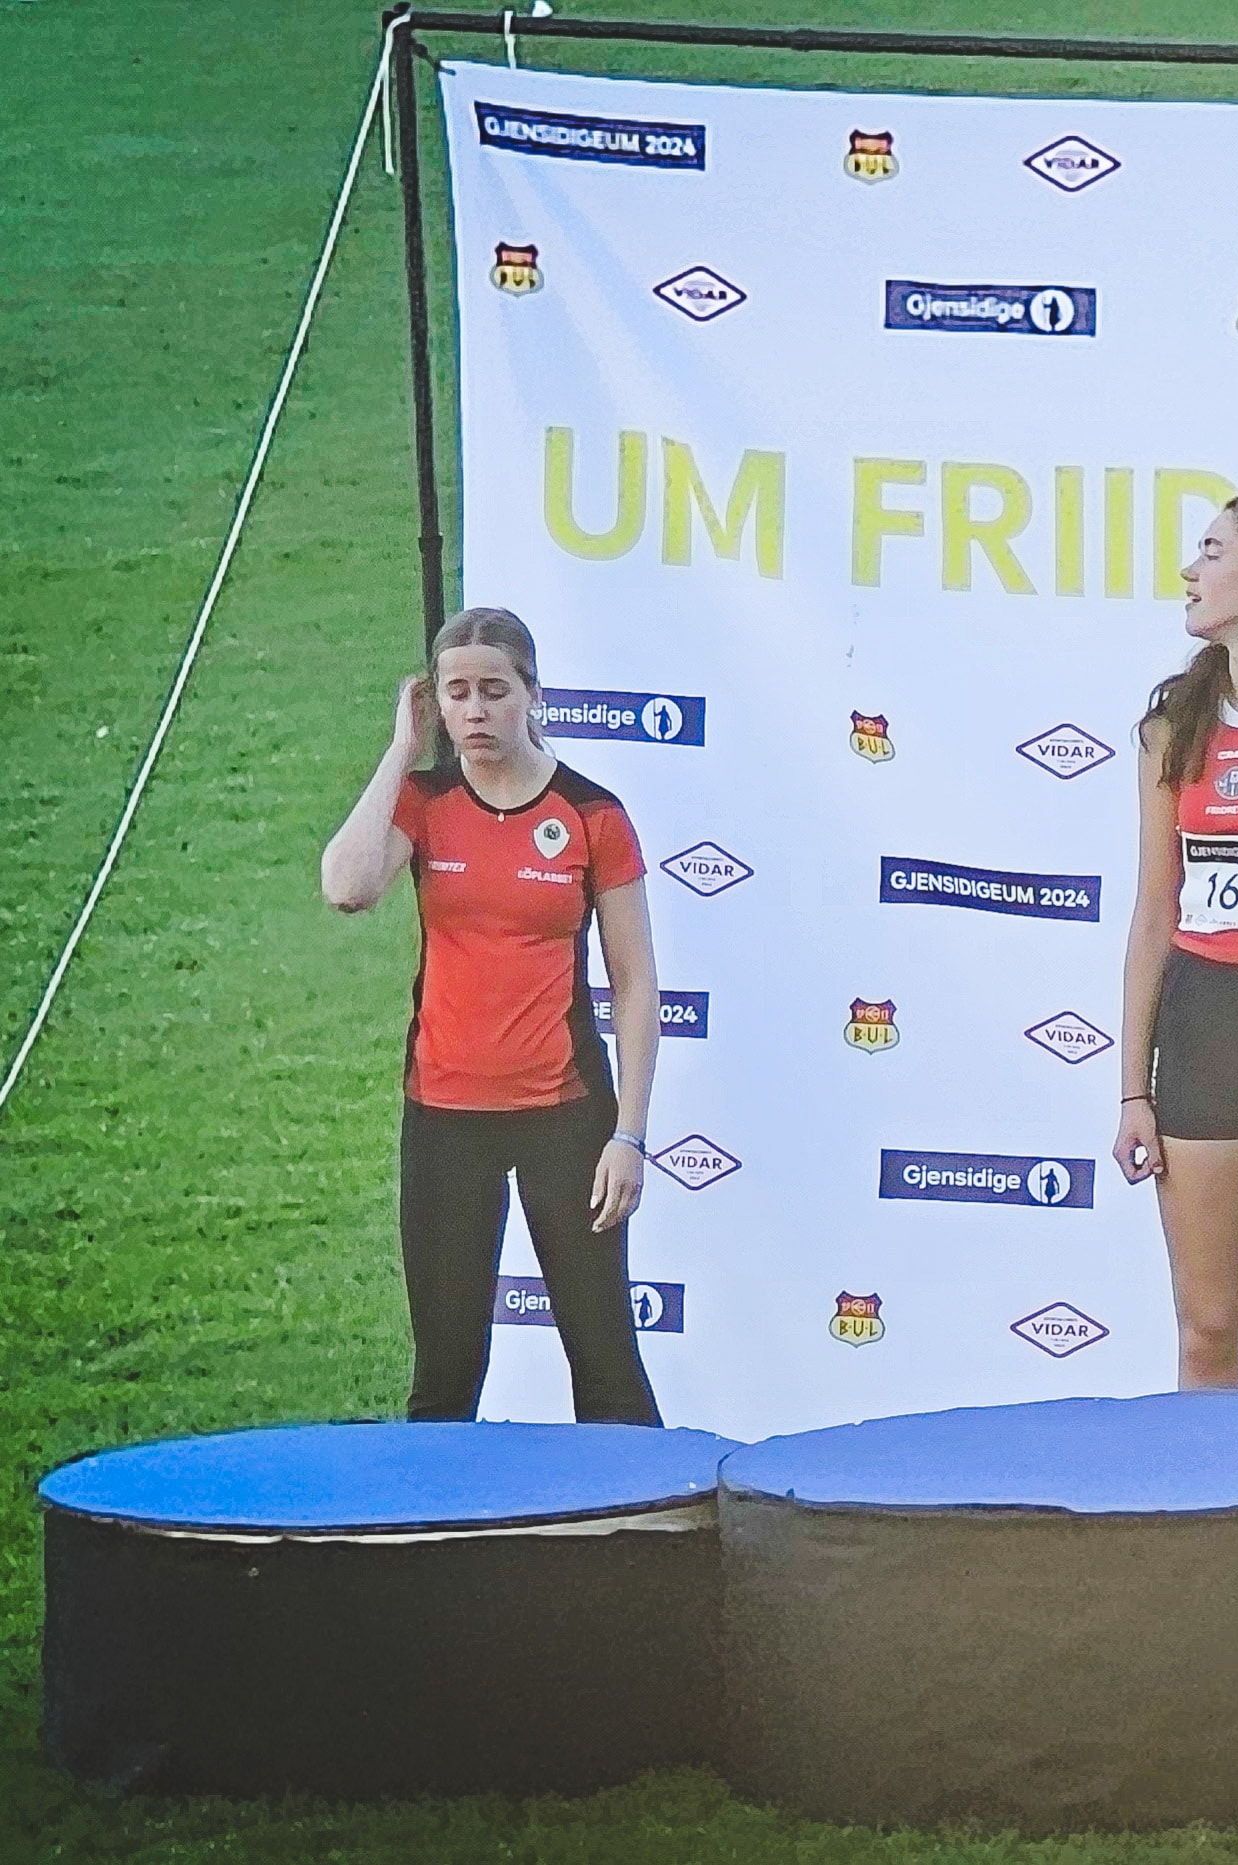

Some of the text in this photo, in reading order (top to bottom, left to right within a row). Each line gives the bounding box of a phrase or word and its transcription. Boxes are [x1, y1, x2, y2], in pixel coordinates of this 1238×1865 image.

[645, 135, 697, 157] 2024
[906, 293, 1026, 323] Gjensidige
[543, 426, 786, 580] UM
[1037, 744, 1095, 759] VIDAR
[679, 860, 735, 878] VIDAR
[890, 870, 1091, 908] GJENSIDIGEUM 2024
[660, 1004, 698, 1024] 024
[1045, 1028, 1098, 1046] VIDAR
[669, 1155, 723, 1171] VIDAR
[903, 1164, 1022, 1194] Gjensidige
[1031, 1322, 1090, 1338] VIDAR
